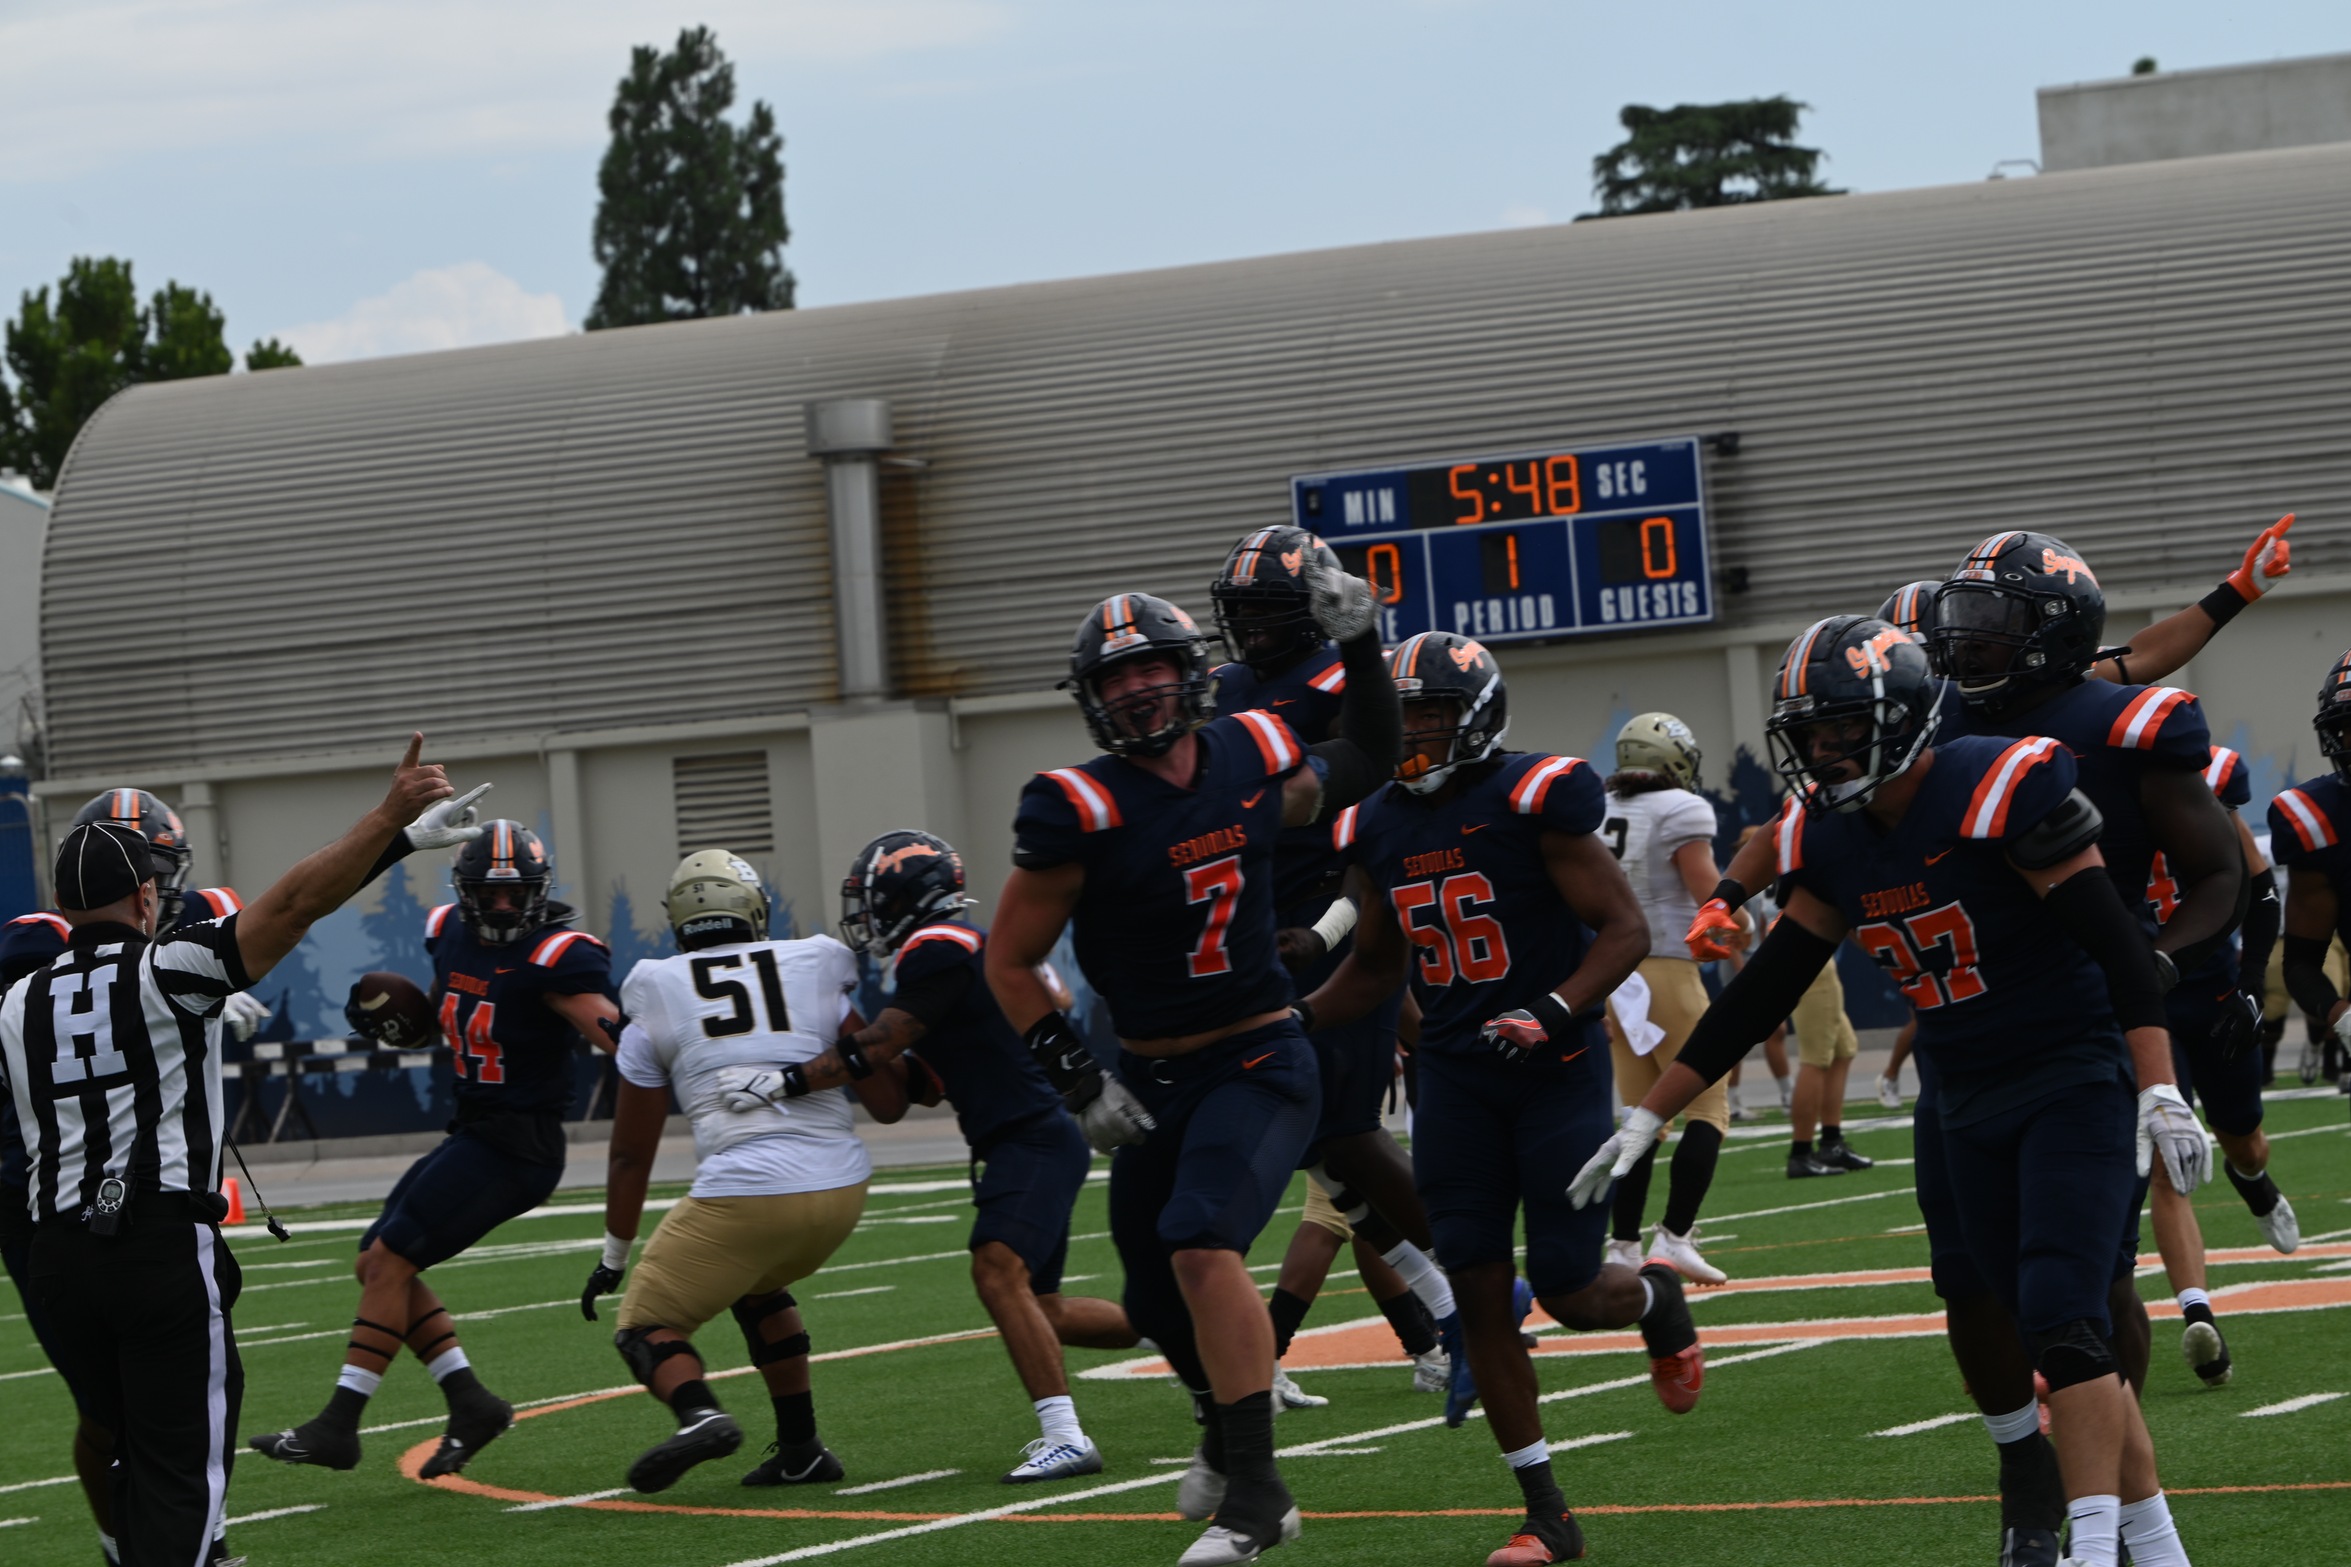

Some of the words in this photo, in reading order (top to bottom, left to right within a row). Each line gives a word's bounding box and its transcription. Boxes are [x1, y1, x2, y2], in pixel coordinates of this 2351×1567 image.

[1344, 488, 1395, 525] MIN
[1449, 455, 1581, 525] 5:48
[1597, 460, 1647, 498] SEC
[1367, 543, 1401, 604] 0
[1506, 534, 1519, 590] 1
[1640, 517, 1676, 579] 0
[1454, 594, 1555, 636] PERIOD
[1600, 581, 1698, 623] GUESTS
[683, 918, 733, 935] Riddell
[1182, 854, 1246, 978] 7
[1390, 871, 1511, 986] 56
[1856, 899, 1988, 1010] 27
[48, 963, 128, 1084] H
[689, 949, 792, 1039] 51
[438, 992, 504, 1084] 44
